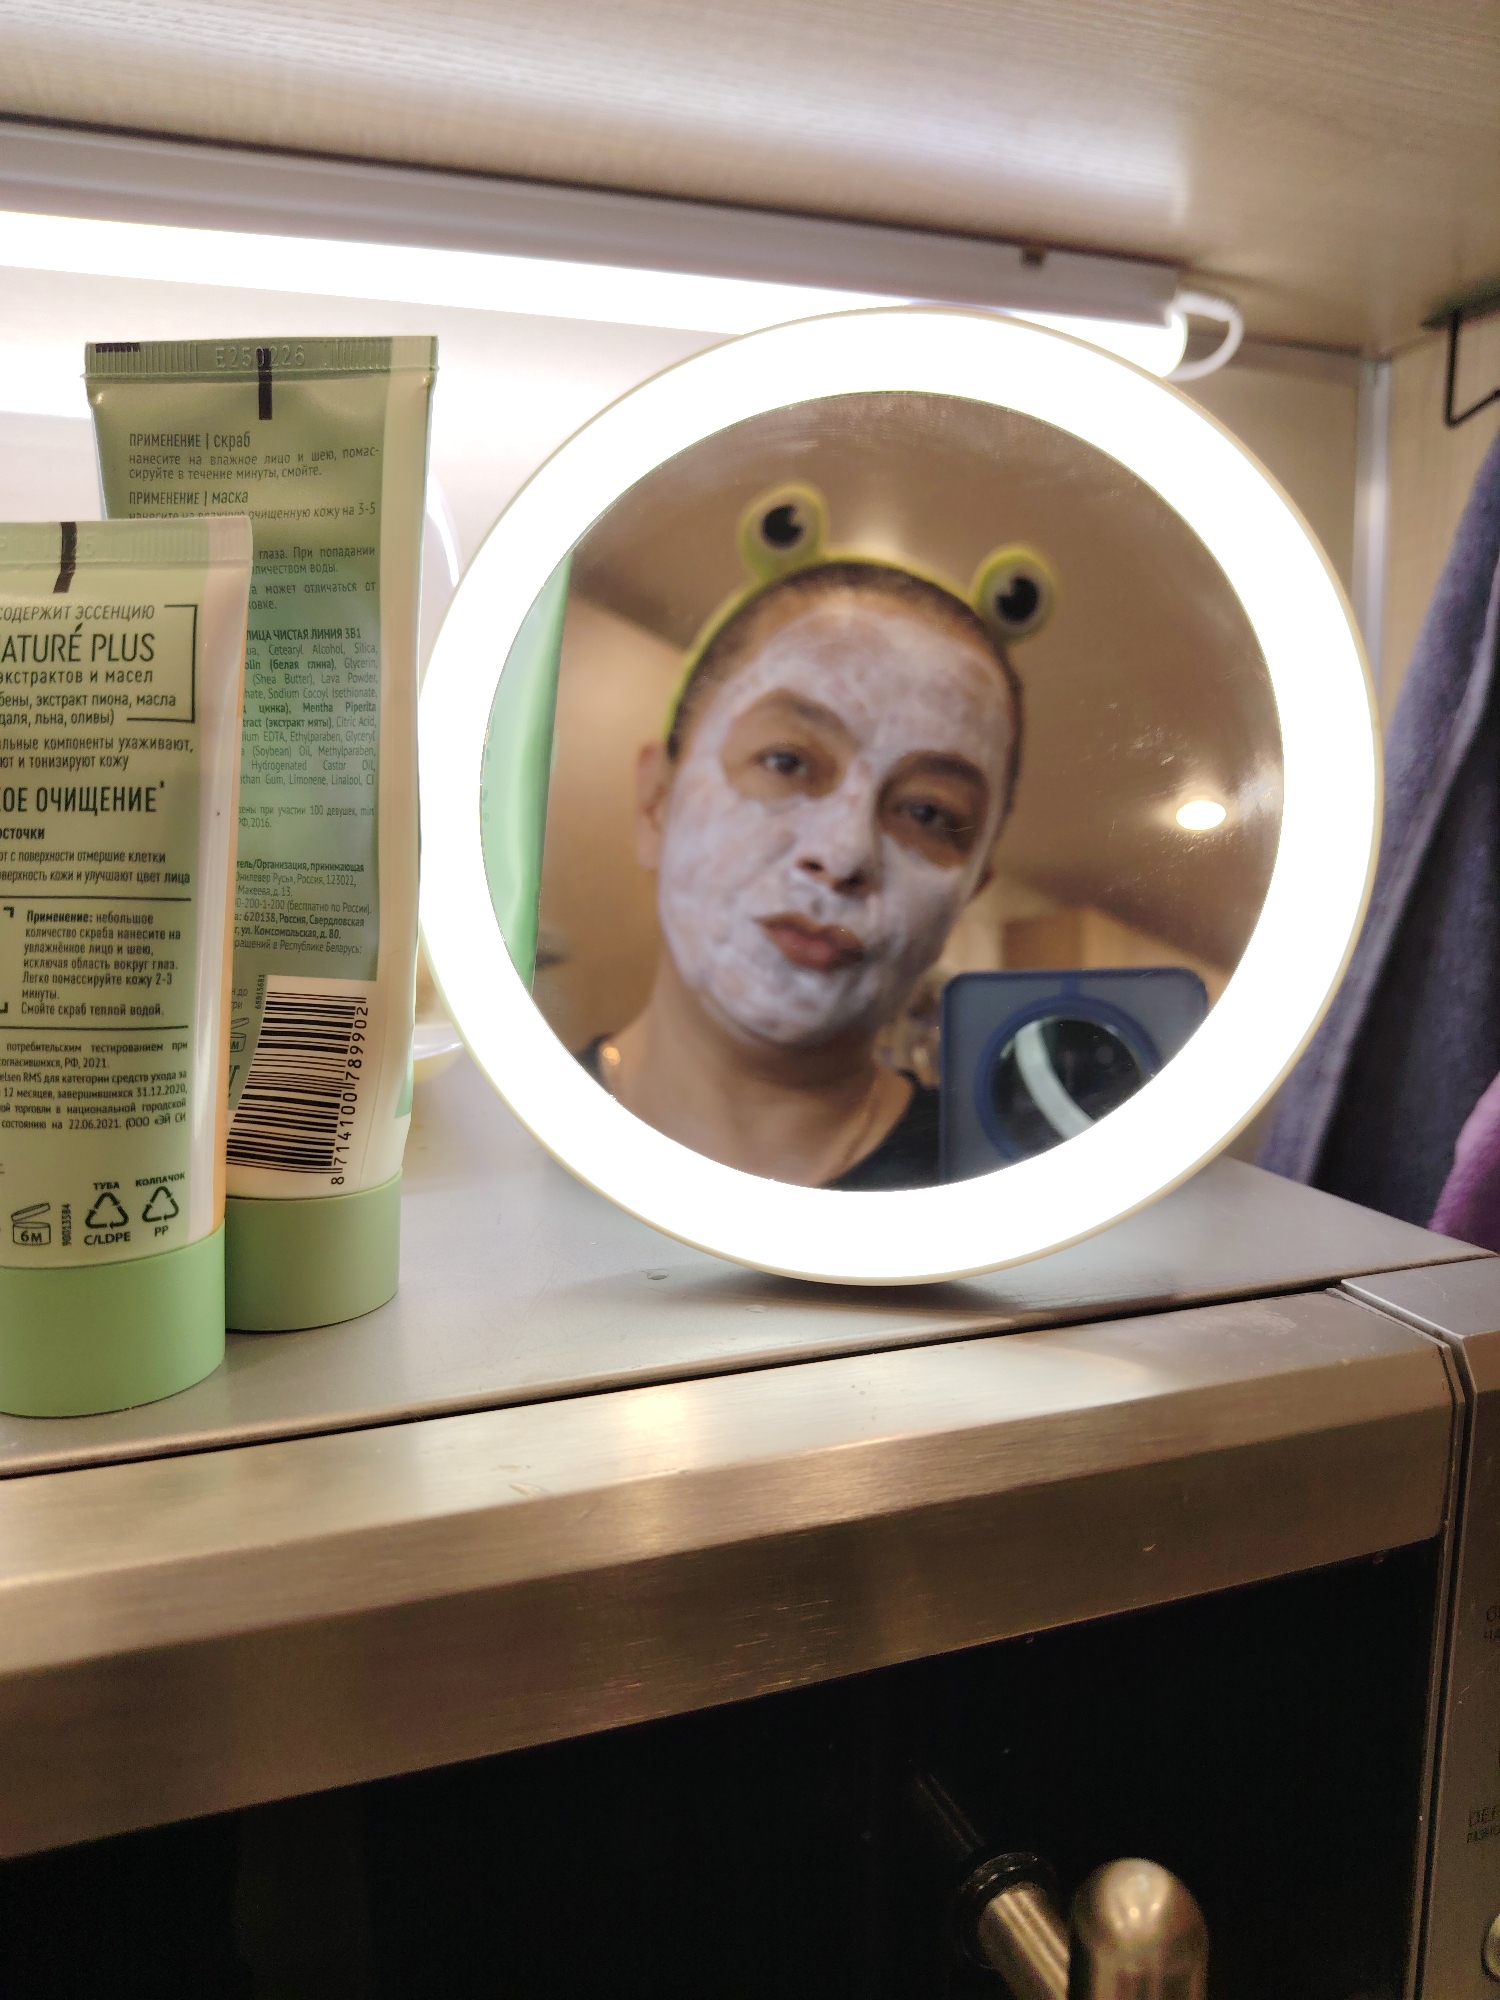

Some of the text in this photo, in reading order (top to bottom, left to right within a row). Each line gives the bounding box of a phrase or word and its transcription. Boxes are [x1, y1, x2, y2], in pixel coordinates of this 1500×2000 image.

[129, 431, 250, 451] ПРИМЕНЕНИЕ скраб
[129, 446, 380, 466] нанесите на влажное лицо и шею, помас-
[129, 465, 322, 482] сируйте в течение минуты, смойте.
[129, 491, 249, 506] ПРИМЕНЕНИЕ маска
[313, 506, 339, 520] кожу
[342, 505, 354, 515] на
[358, 502, 376, 516] 3-5
[259, 547, 375, 561] глаза. При попадании
[310, 563, 338, 574] воды.
[265, 584, 296, 595] может
[304, 581, 357, 594] отличаться
[365, 581, 376, 592] от
[74, 603, 155, 620] ЭССЕНЦИЮ
[274, 629, 309, 641] ЧИСТАЯ
[311, 628, 342, 640] ЛИНИЯ
[91, 633, 156, 663] PLUS
[90, 670, 98, 683] и
[105, 669, 153, 683] масел
[36, 694, 88, 710] экстракт
[91, 694, 132, 709] пиона,
[136, 694, 176, 707] масла
[35, 708, 115, 728] льна, оливы)
[0, 736, 194, 753] льные компоненты ухаживают,
[18, 755, 129, 771] и тонизируют кожу
[0, 786, 28, 813] ОЕ
[18, 851, 75, 865] поверхности
[77, 852, 125, 865] отмершие
[128, 852, 166, 863] клетки
[50, 871, 74, 882] кожи
[85, 871, 132, 884] улучшают
[136, 872, 160, 884] цвет
[164, 871, 191, 884] лица
[27, 909, 154, 925] Применение: небольшое
[25, 926, 181, 941] количество скраба нанесите на
[89, 944, 114, 956] лицо
[24, 957, 178, 973] исключая область вокруг глаз.
[23, 971, 173, 988] Легко помассируйте кожу 2-3
[22, 988, 60, 1002] минуты.
[21, 1002, 164, 1018] Смойте скраб теплой водой.
[7, 1040, 188, 1055] потребительским тестированием при
[64, 1057, 109, 1069] РФ, 2021.
[23, 1072, 42, 1084] RMS
[43, 1073, 60, 1086] для
[62, 1074, 109, 1087] категории
[112, 1073, 148, 1086] средств
[151, 1072, 177, 1085] ухода
[67, 1103, 136, 1116] национальной
[142, 1099, 187, 1113] городской
[93, 1181, 120, 1191] ТУБА
[135, 1172, 186, 1188] КОЛПАЧОК
[84, 1231, 131, 1246] C/LDPE
[154, 1225, 169, 1238] PP
